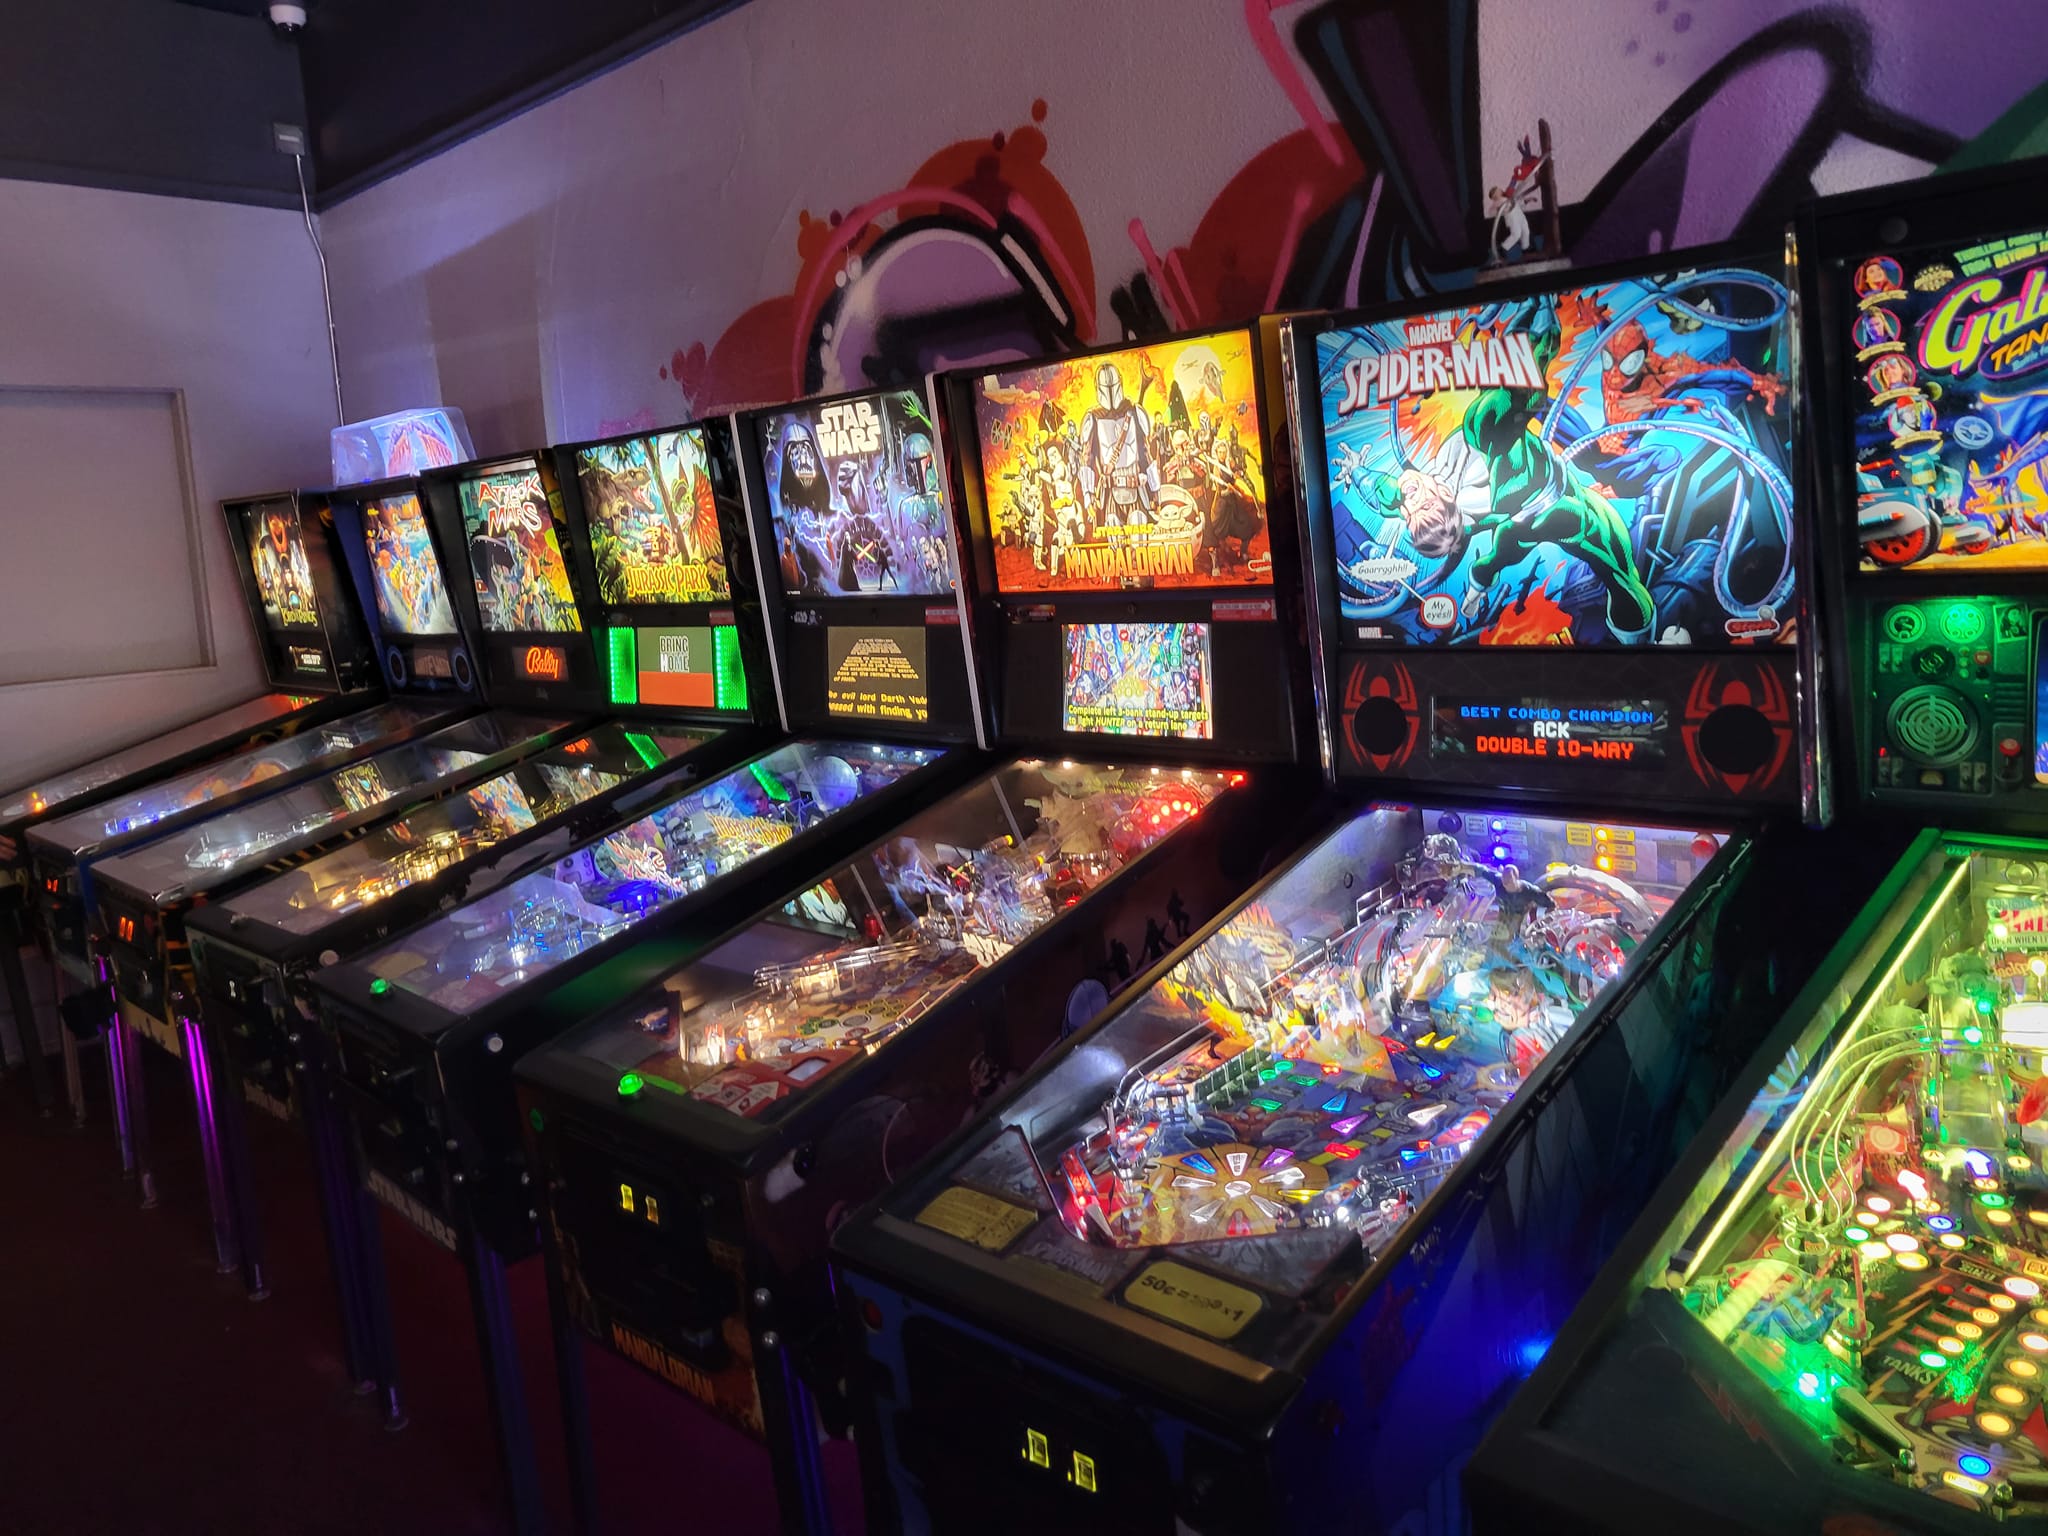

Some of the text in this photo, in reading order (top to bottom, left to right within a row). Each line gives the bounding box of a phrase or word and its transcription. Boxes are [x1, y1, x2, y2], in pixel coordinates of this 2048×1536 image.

[1408, 322, 1455, 346] MARVEL
[1338, 332, 1546, 416] SPIDER-MAN
[816, 401, 879, 433] STAR
[818, 425, 881, 458] WARS
[487, 501, 543, 539] MARS
[1093, 523, 1155, 539] STAR WARS
[1064, 543, 1194, 579] MANDALORIAN
[626, 563, 711, 604] JURASSIC PARK
[1431, 601, 1446, 611] My
[660, 635, 689, 653] BRING
[526, 646, 560, 680] Bally
[660, 653, 690, 673] HOME
[841, 691, 856, 700] evil
[859, 692, 876, 701] lord
[880, 693, 906, 703] Darth
[857, 703, 875, 714] with
[880, 704, 912, 719] finding
[1068, 705, 1102, 716] Complete
[1103, 705, 1116, 716] left
[1145, 707, 1179, 721] stand-up
[1180, 709, 1209, 721] targets
[1460, 706, 1653, 723] BEST COMBO CHAMPION
[1095, 716, 1126, 728] HUNTER
[1126, 720, 1136, 728] on
[1144, 720, 1169, 730] return
[1170, 720, 1188, 731] lane
[1533, 721, 1570, 738] ACK
[1476, 736, 1635, 760] DOUBLE 10-WAY
[1883, 1355, 1938, 1385] TANKS
